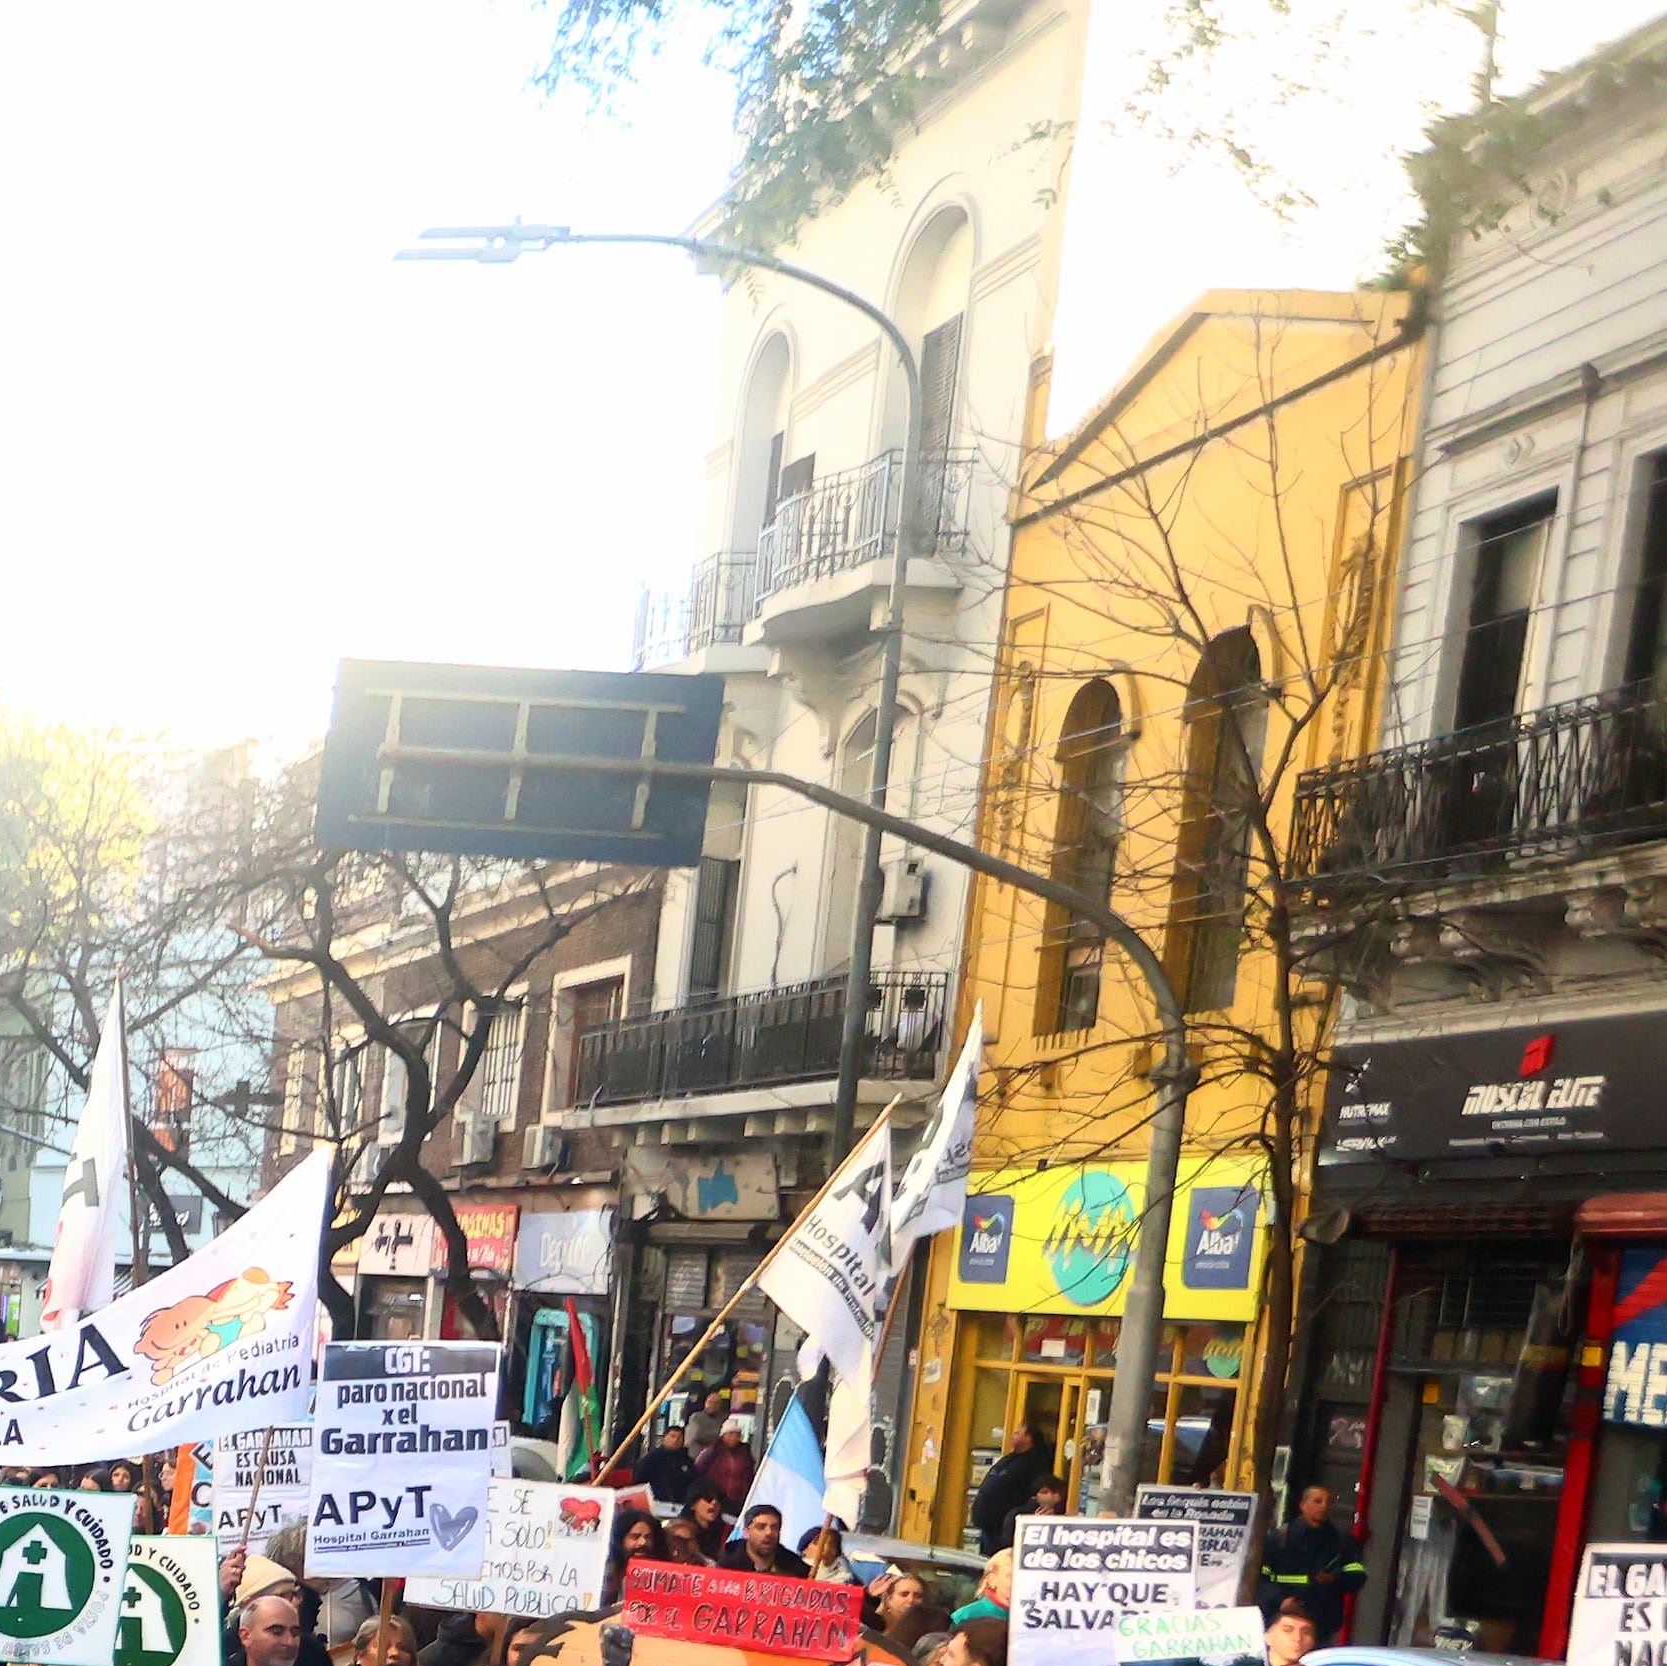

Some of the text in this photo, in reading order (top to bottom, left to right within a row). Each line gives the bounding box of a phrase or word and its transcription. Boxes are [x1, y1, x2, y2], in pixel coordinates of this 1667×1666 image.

[803, 1214, 878, 1298] Hospital
[225, 1331, 300, 1369] Pediatría
[384, 1346, 431, 1375] CGT:
[126, 1361, 303, 1434] Garrahan
[337, 1373, 487, 1409] paro nacional
[381, 1402, 418, 1426] x el
[320, 1425, 489, 1456] Garrahan
[236, 1453, 250, 1468] ES
[12, 1493, 61, 1510] SALUD
[63, 1498, 74, 1515] Y
[313, 1484, 433, 1530] APyT
[313, 1527, 430, 1545] Hospital Garrahan
[1023, 1525, 1192, 1551] El hospital es
[1022, 1548, 1189, 1572] de los chicos
[149, 1546, 201, 1612] Y CUIDADO
[559, 1562, 579, 1588] LA
[1588, 1564, 1624, 1598] EL
[432, 1578, 497, 1611] SALUD
[629, 1566, 852, 1616] SUMATE BRIGADAS
[1039, 1580, 1170, 1608] HAY QUE
[629, 1600, 659, 1626] POR
[692, 1602, 854, 1651] GARRAHAN
[1022, 1607, 1149, 1631] SALVA
[1117, 1611, 1224, 1639] GRACIAS
[1619, 1603, 1651, 1633] ES
[1131, 1632, 1254, 1660] GARRAHAN
